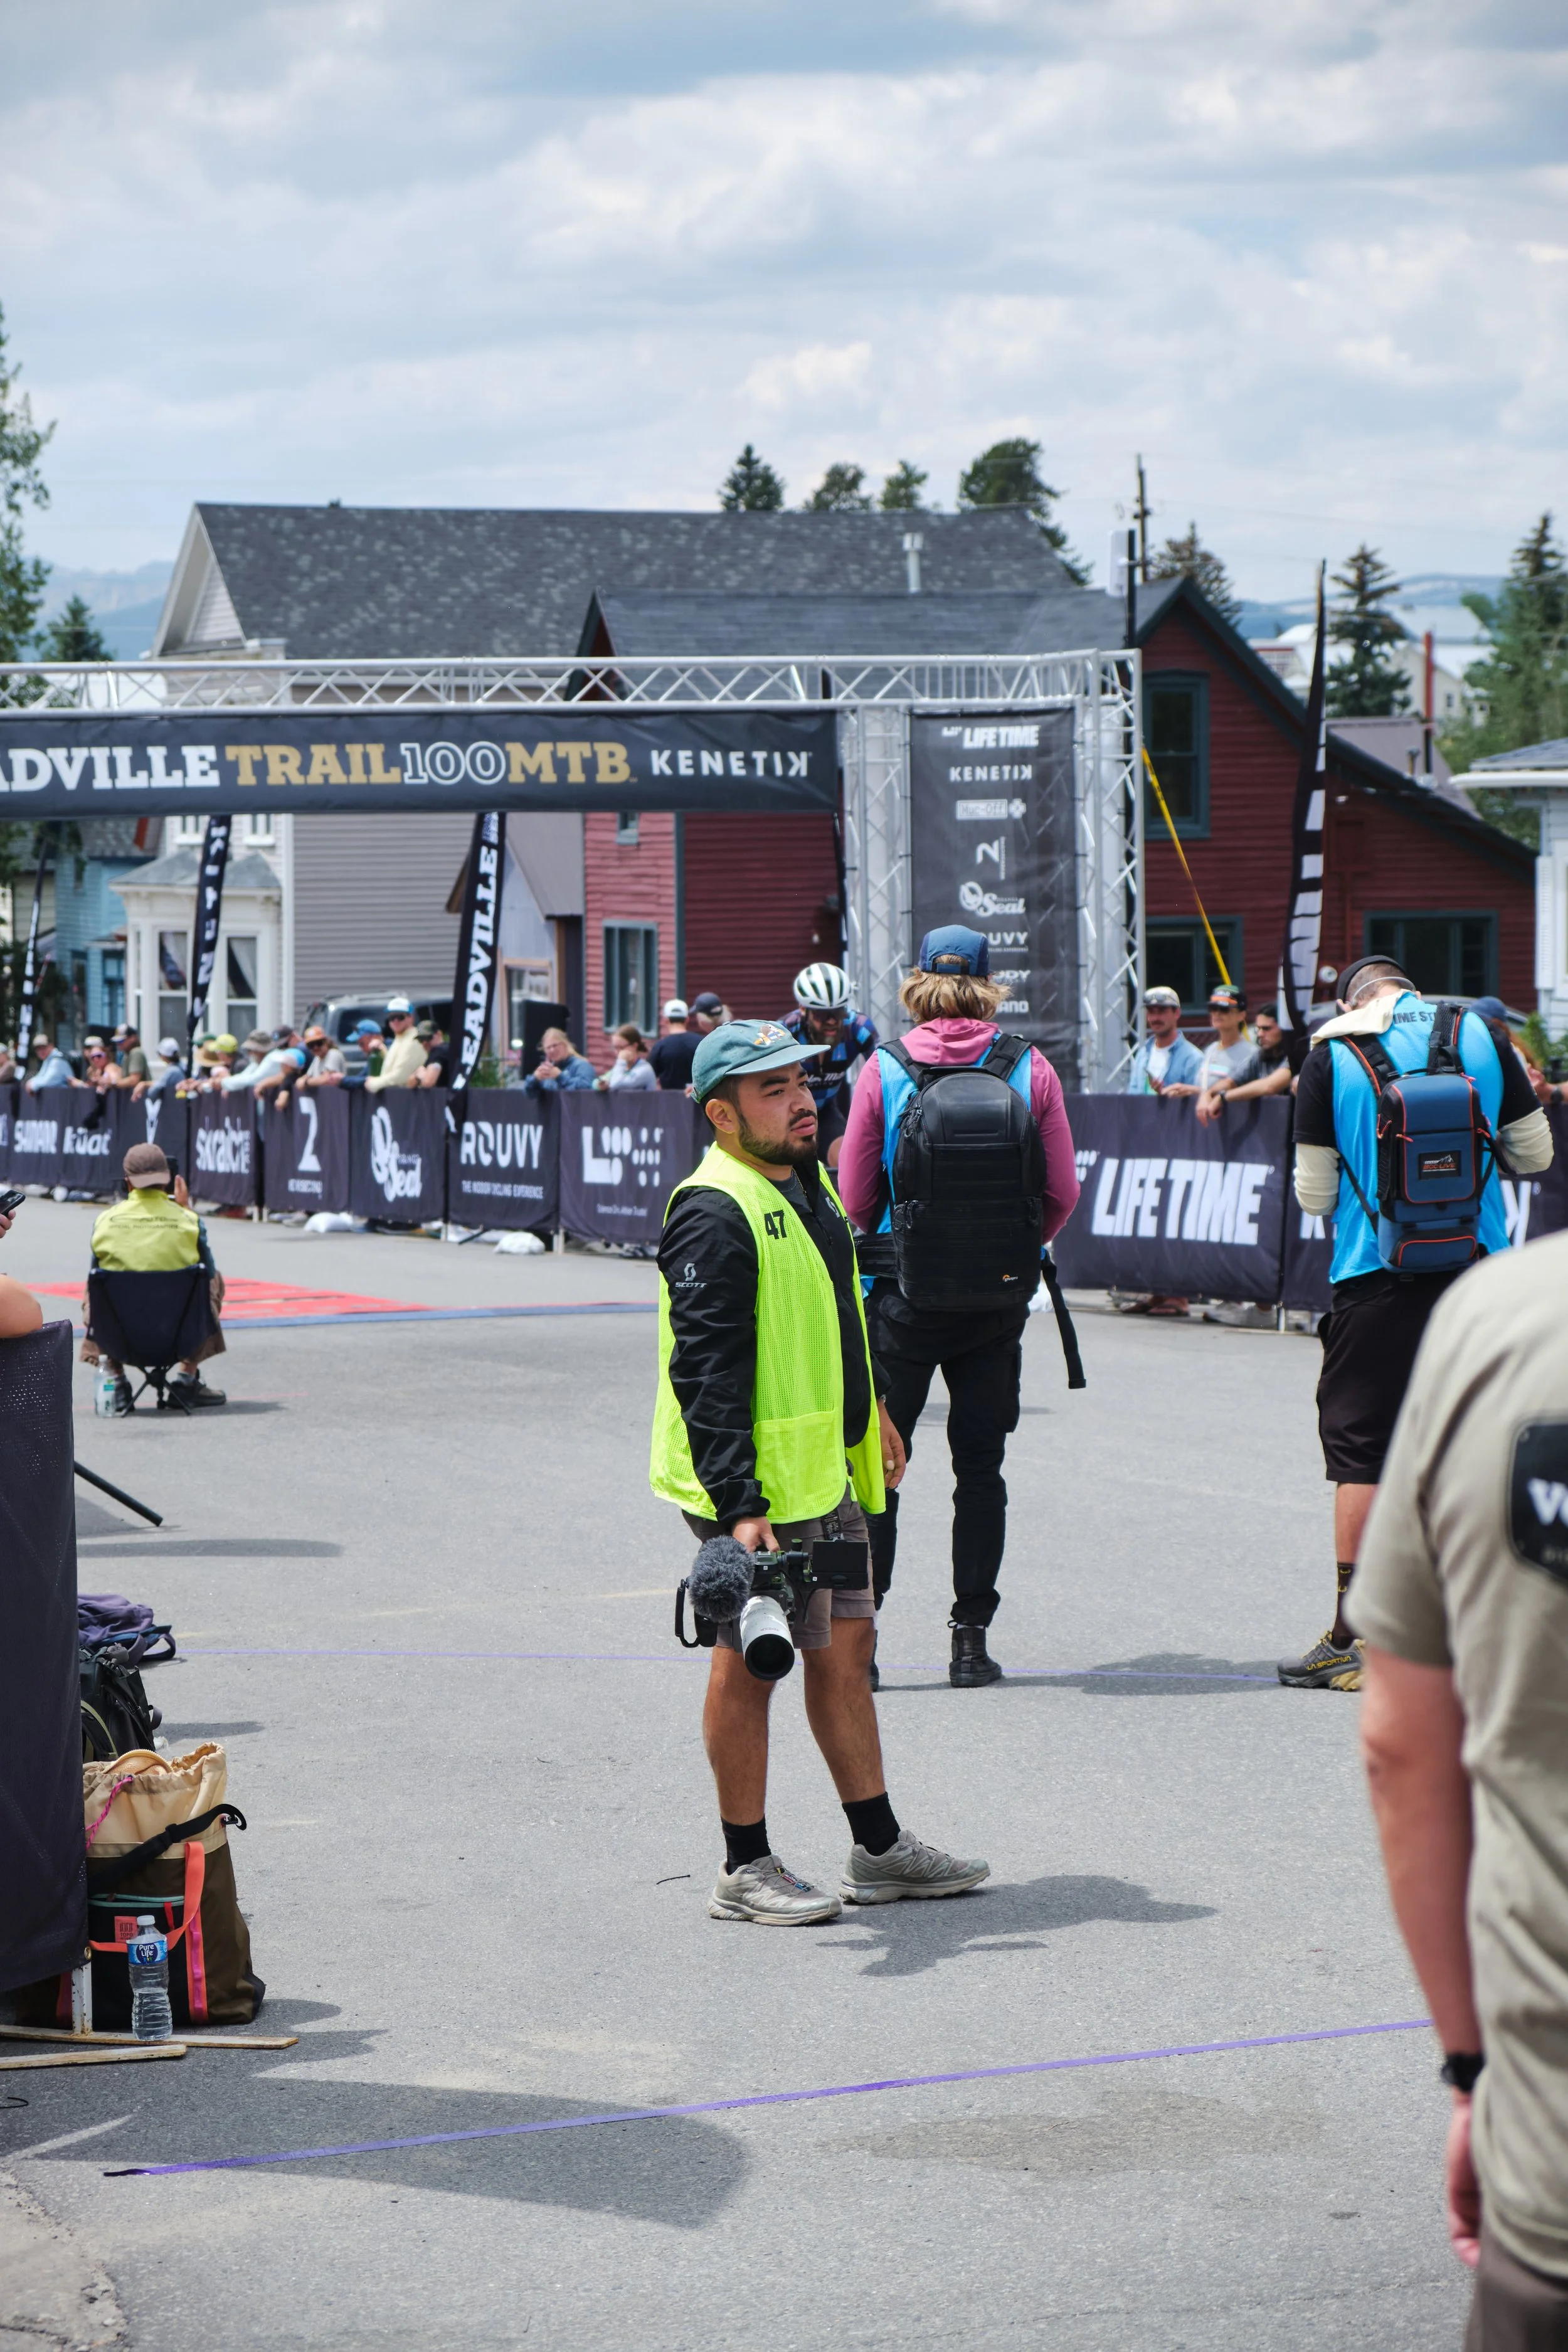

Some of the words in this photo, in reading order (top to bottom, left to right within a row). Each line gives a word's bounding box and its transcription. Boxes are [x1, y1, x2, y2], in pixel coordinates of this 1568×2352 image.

[226, 743, 401, 786] TRAIL
[400, 741, 506, 785] 100
[506, 741, 631, 783] MTB
[651, 750, 808, 777] KENETIK
[950, 765, 1032, 782] KENETIK
[961, 802, 1005, 815] Muc-Off
[975, 893, 1025, 917] Seal
[980, 931, 1028, 945] UVY
[1394, 1011, 1417, 1024] IME
[461, 1121, 543, 1169] ROUVY
[764, 1209, 787, 1239] 47
[141, 1949, 153, 1957] Life
